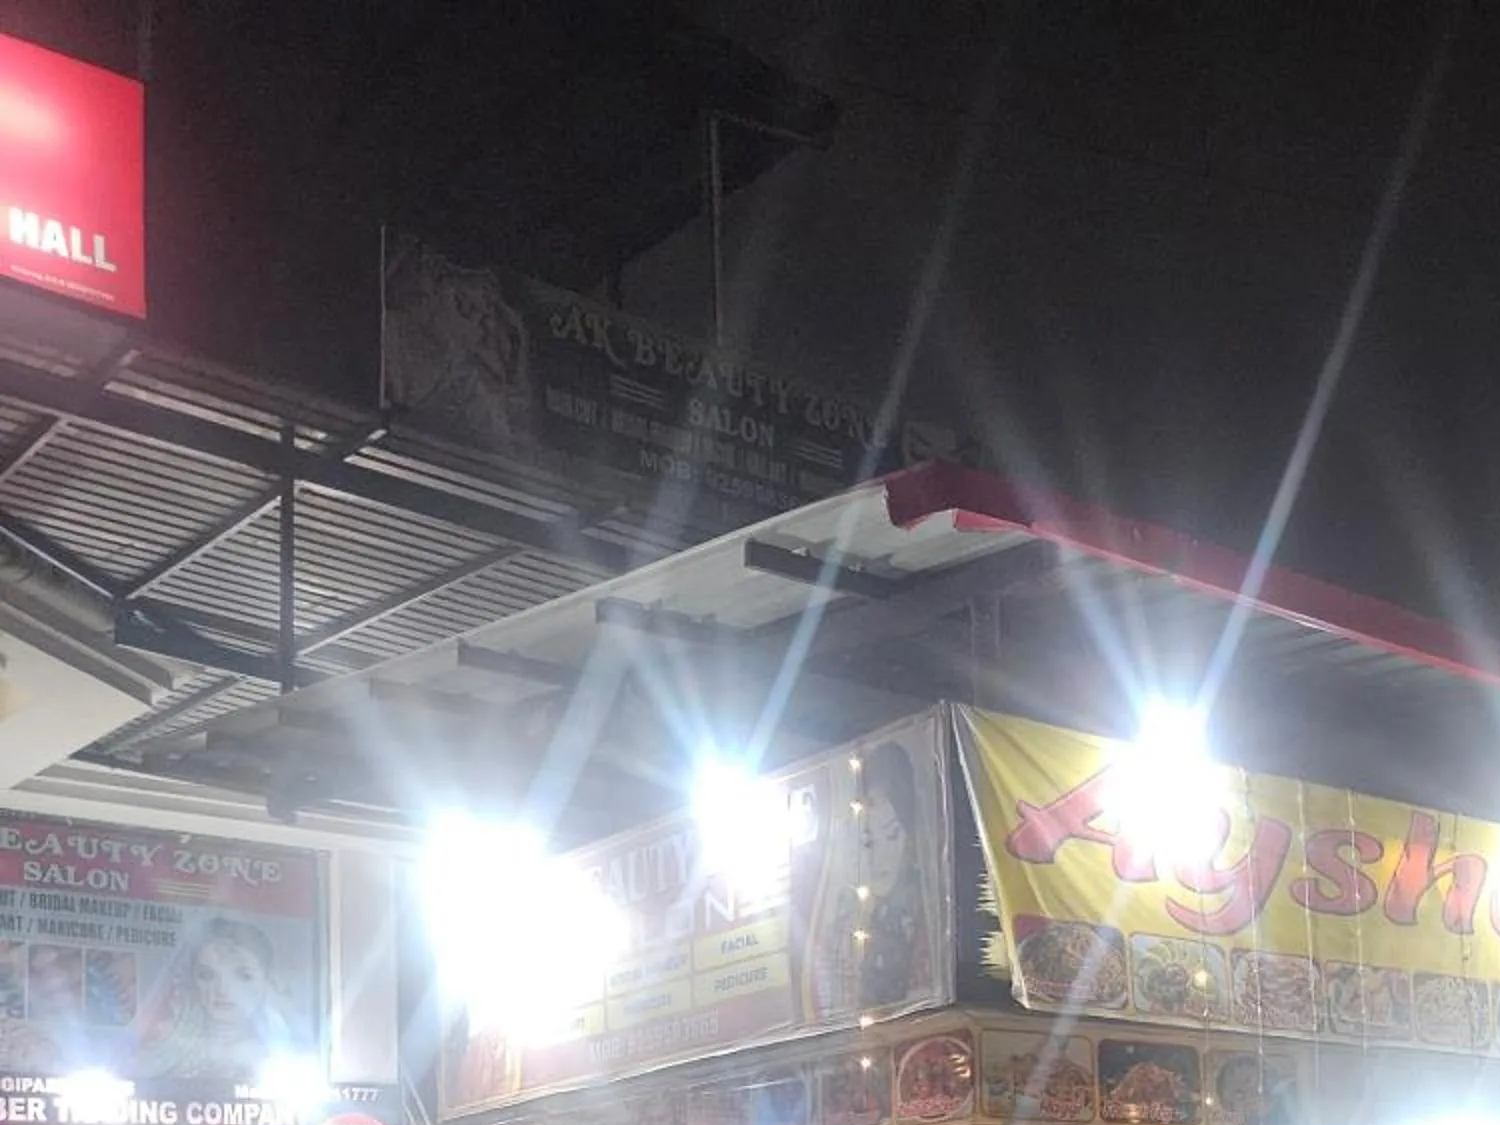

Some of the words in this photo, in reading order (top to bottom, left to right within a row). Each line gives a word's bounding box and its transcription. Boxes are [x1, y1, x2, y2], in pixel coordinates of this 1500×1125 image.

[8, 205, 118, 273] HALL
[687, 396, 775, 448] SALON
[22, 860, 130, 891] SALON
[173, 846, 284, 886] ZONE
